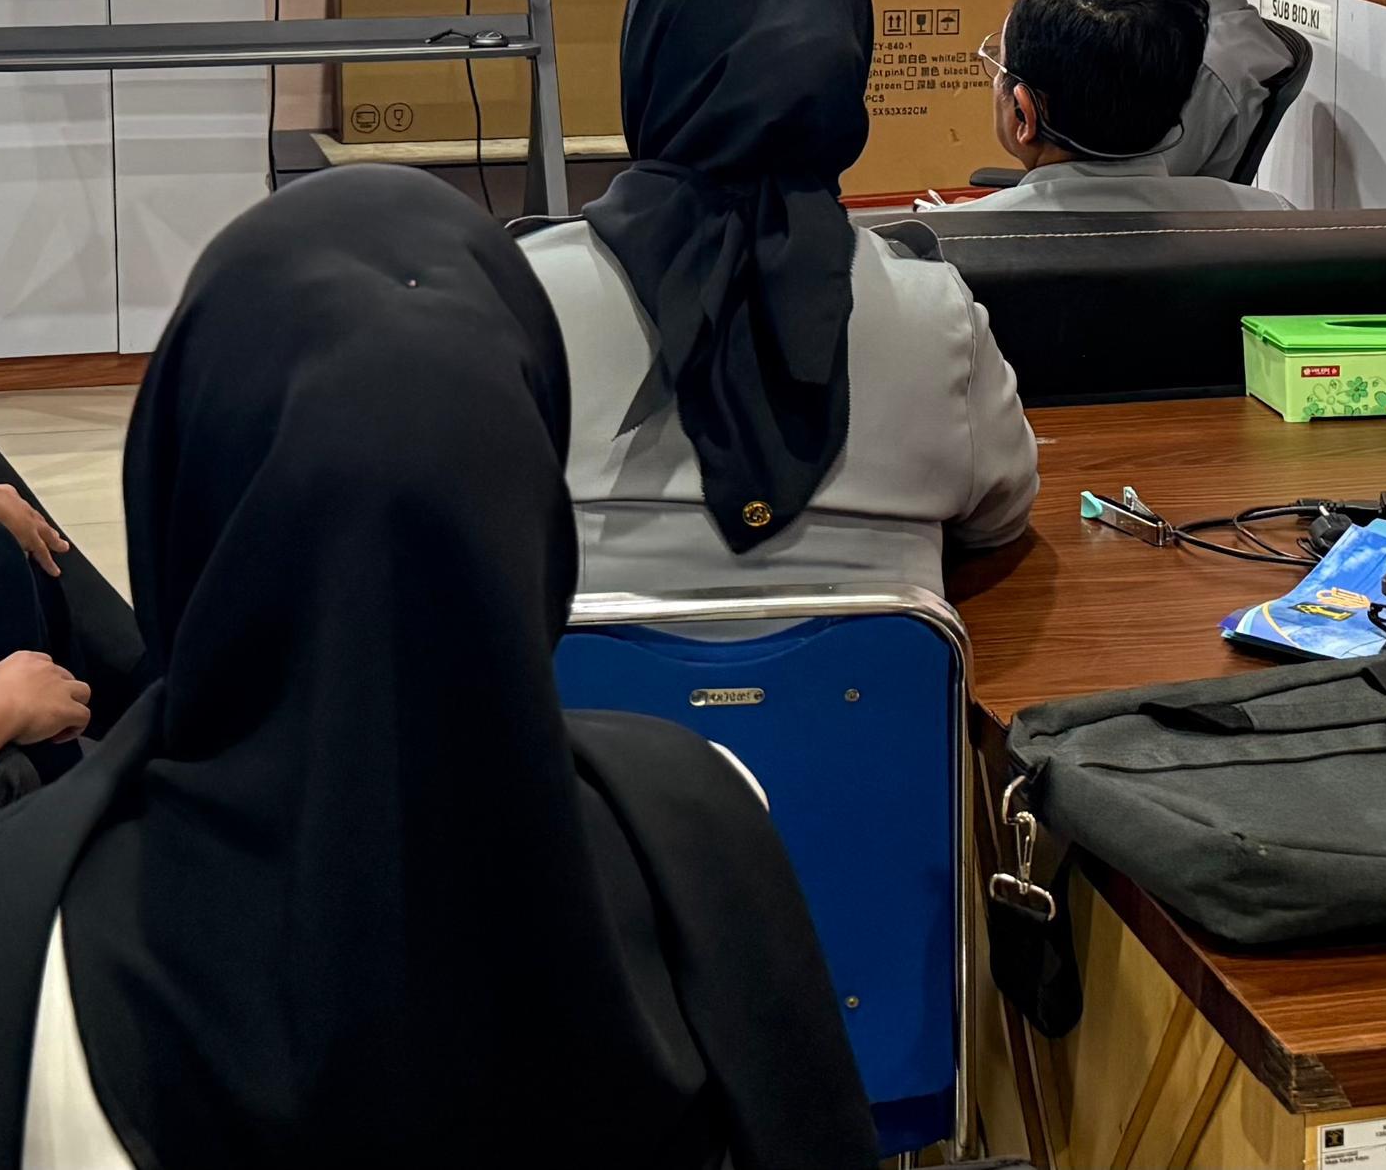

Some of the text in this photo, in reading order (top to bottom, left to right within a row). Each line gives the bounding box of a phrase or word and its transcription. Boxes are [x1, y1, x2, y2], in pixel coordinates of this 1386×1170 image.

[1291, 4, 1320, 30] BID.KI
[931, 55, 957, 63] white
[884, 69, 905, 79] pink
[943, 67, 969, 76] black
[874, 81, 902, 92] green
[940, 80, 990, 90] dark green
